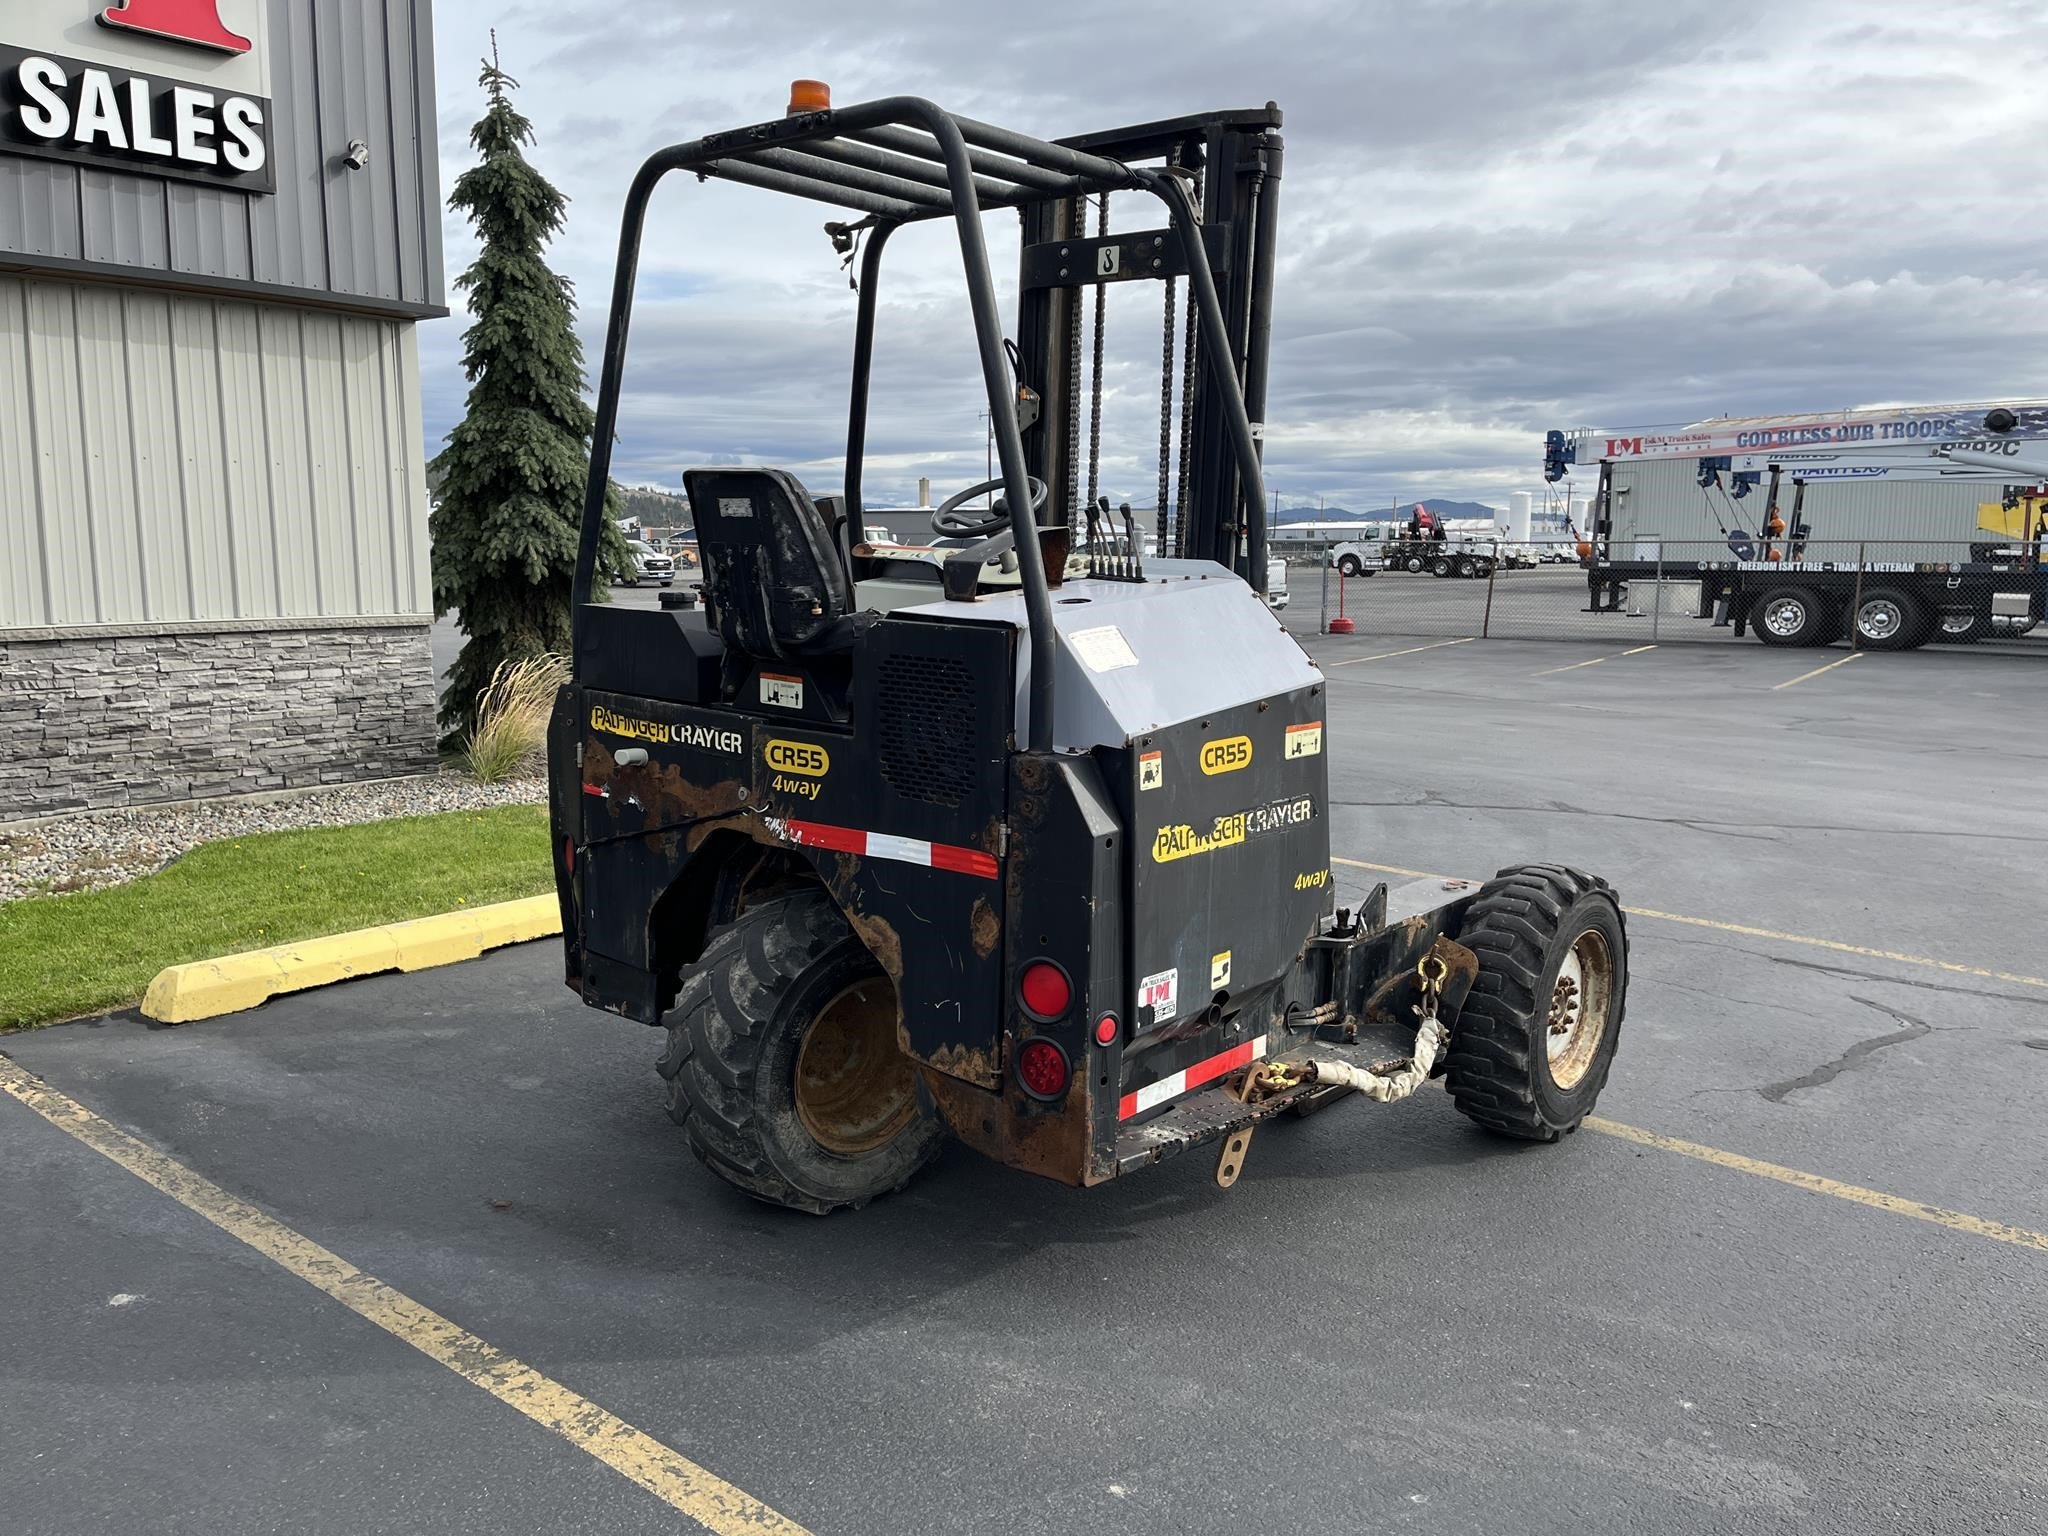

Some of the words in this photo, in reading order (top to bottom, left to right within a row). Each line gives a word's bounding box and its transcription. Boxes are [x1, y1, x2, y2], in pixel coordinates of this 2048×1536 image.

[18, 56, 266, 172] SALES
[1736, 431, 1773, 448] GOD
[1775, 426, 1832, 446] BLESS
[1836, 423, 1874, 442] OUR
[1879, 418, 1957, 439] TROOPS
[1736, 561, 1777, 571] FREEDOM
[1802, 563, 1824, 572] FREE
[1865, 562, 1873, 572] A
[1873, 562, 1916, 572] VETERAN
[671, 724, 742, 755] CRAYLER
[770, 745, 823, 770] CR55
[1204, 742, 1247, 768] CR55
[772, 774, 821, 801] 4way
[1246, 799, 1311, 832] CRAYLER
[1294, 868, 1329, 891] 4way
